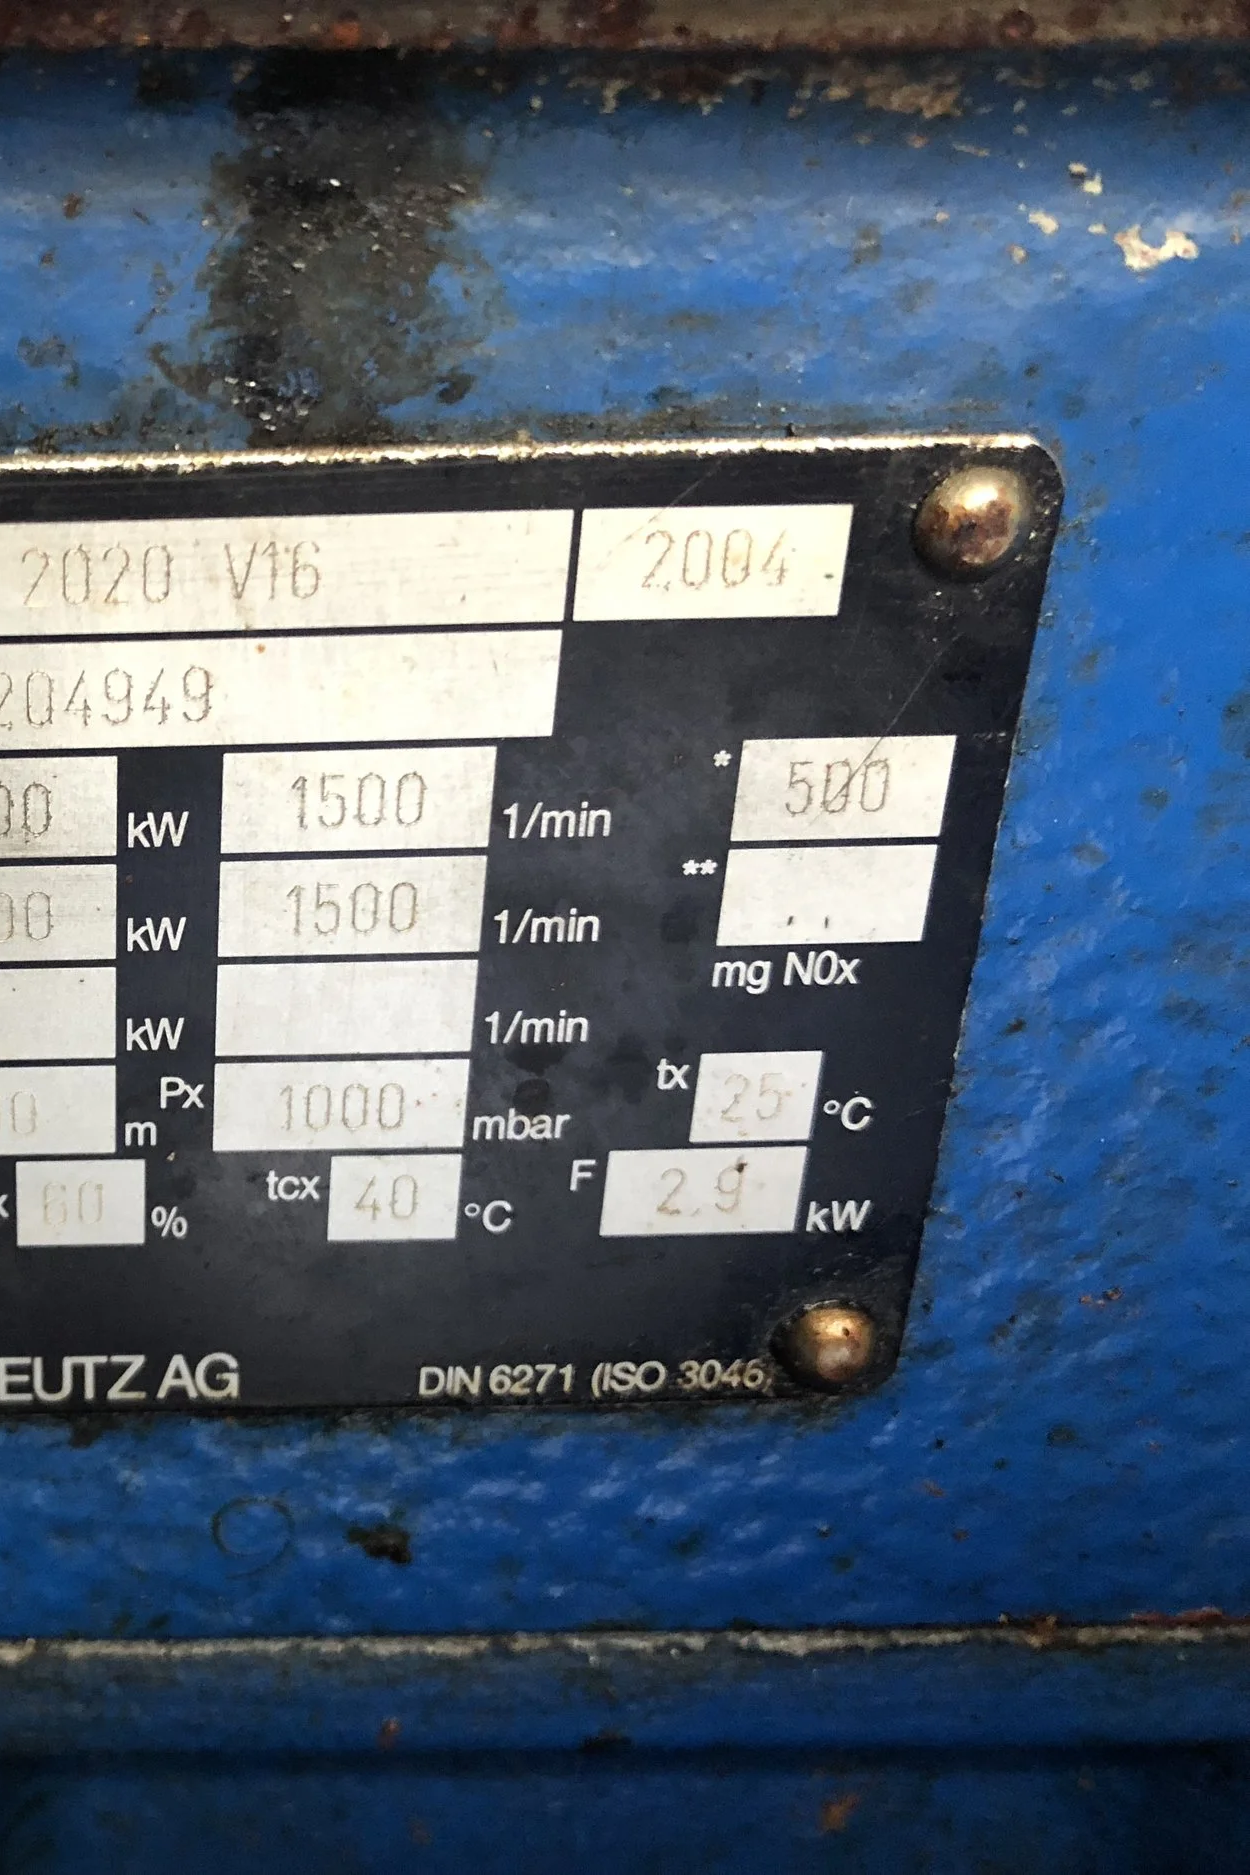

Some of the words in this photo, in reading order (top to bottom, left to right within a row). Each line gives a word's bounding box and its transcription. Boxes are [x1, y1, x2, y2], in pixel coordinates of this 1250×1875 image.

[22, 546, 171, 606] 2020
[226, 541, 321, 600] V16
[640, 529, 790, 590] 2004
[291, 773, 427, 830] 1500
[784, 758, 890, 817] 500
[127, 811, 189, 848] kW
[504, 804, 612, 840] 1/min
[286, 883, 420, 936] 1500
[126, 916, 187, 951] kW
[495, 911, 600, 945] 1/min
[712, 960, 771, 994] mg
[125, 1018, 183, 1051] kW
[485, 1013, 588, 1045] 1/min
[656, 1058, 690, 1090] tx
[159, 1076, 205, 1109] Px
[279, 1082, 406, 1134] 1000
[719, 1072, 785, 1123] 25
[124, 1120, 158, 1146] m
[472, 1111, 569, 1144] mbar
[266, 1168, 321, 1201] tcx
[570, 1160, 596, 1191] F
[43, 1180, 104, 1227] 60
[352, 1173, 420, 1221] 40
[151, 1205, 188, 1238] %
[805, 1200, 871, 1232] kW
[155, 1352, 240, 1399] AG
[418, 1365, 482, 1397] DIN
[488, 1363, 574, 1395] 6271
[590, 1359, 667, 1399] (ISO
